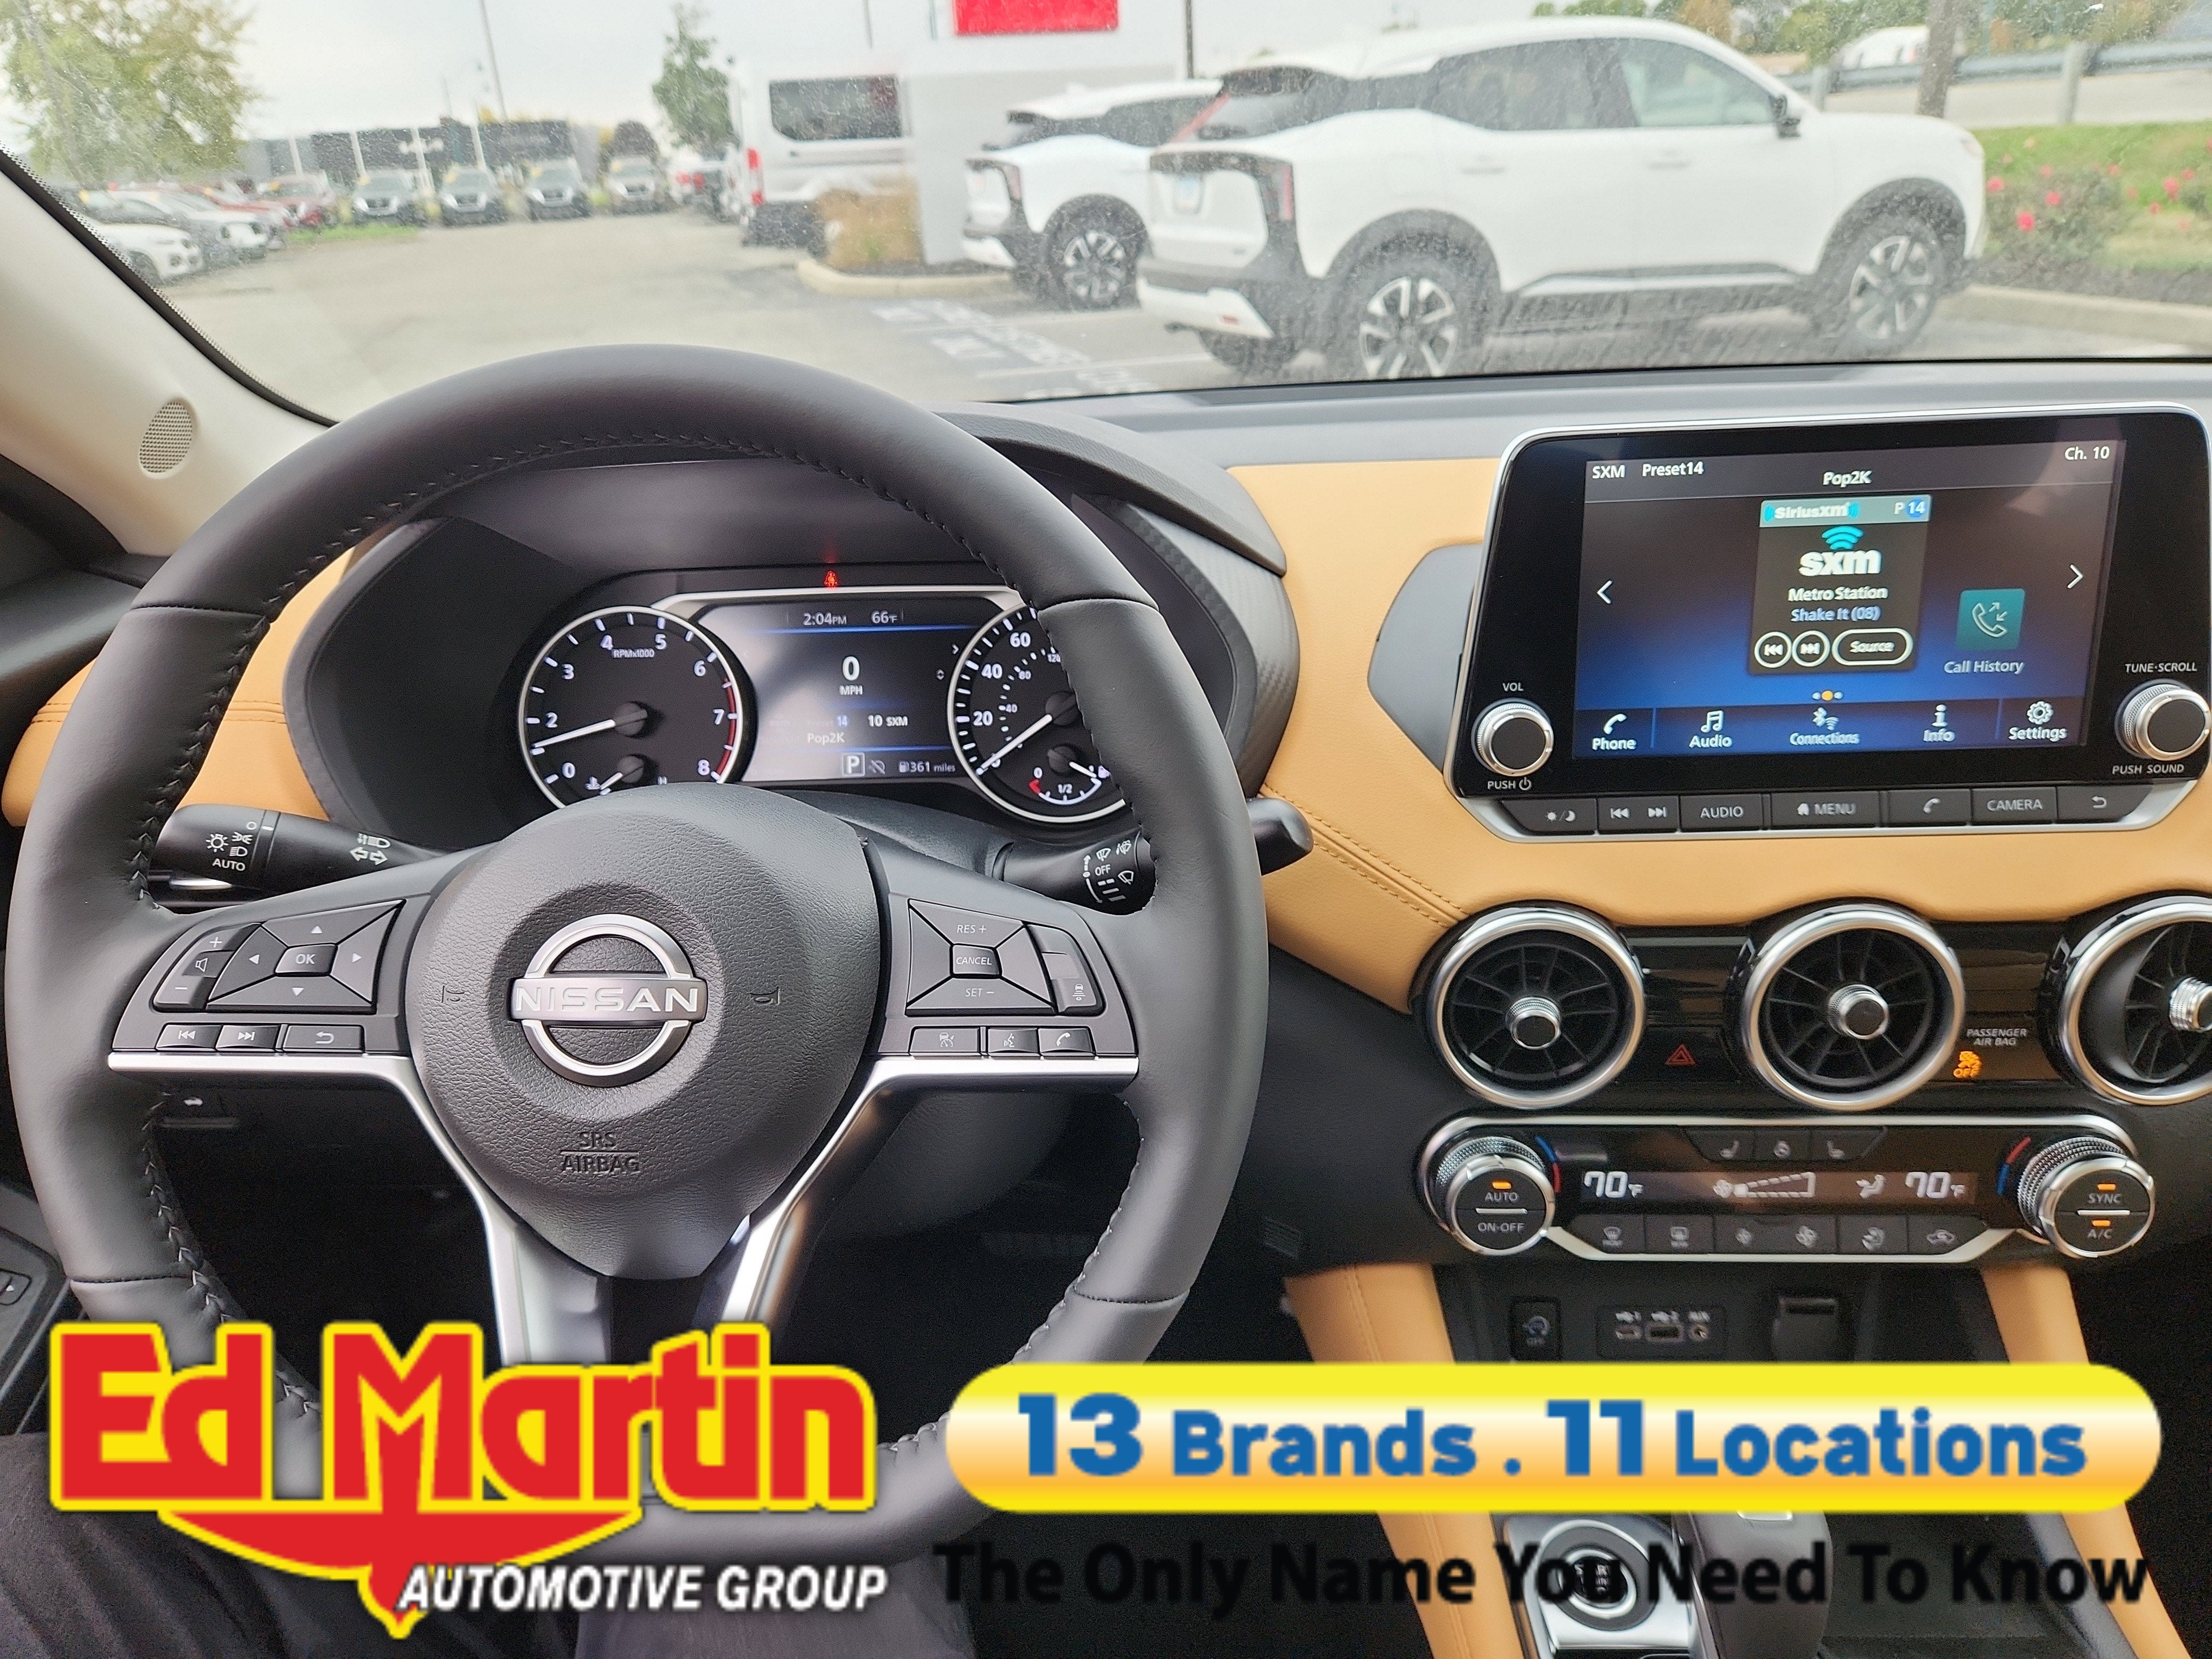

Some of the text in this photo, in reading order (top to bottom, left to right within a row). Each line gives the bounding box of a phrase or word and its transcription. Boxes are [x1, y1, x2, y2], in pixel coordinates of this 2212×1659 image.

[2063, 445, 2110, 460] Ch. 10
[1591, 461, 1705, 479] SXM Preset14
[1823, 470, 1872, 487] Pop2K
[1894, 500, 1926, 515] P 14
[1799, 549, 1881, 576] sxm
[1788, 585, 1889, 602] Metro Station
[1790, 605, 1881, 622] Shake It (08)
[600, 634, 613, 650] 4
[655, 633, 667, 650] 5
[1009, 632, 1031, 647] 60
[1849, 639, 1895, 653] Source
[563, 664, 575, 680] 3
[694, 660, 706, 677] 6
[841, 656, 860, 681] 0
[981, 664, 1003, 679] 40
[1944, 658, 2025, 674] Call History
[839, 685, 863, 695] MPH
[1502, 681, 1524, 692] VOL
[1005, 704, 1018, 713] 40
[545, 712, 558, 728] 2
[713, 709, 725, 725] 7
[838, 715, 848, 727] 14
[868, 715, 908, 727] 10 SXM
[973, 711, 993, 726] 20
[807, 732, 845, 745] Pop2K
[1689, 734, 1733, 749] Audio
[1789, 731, 1860, 747] Connections
[1923, 728, 1955, 743] Info
[2008, 725, 2067, 743] Settings
[1592, 736, 1636, 751] Phone
[562, 762, 575, 778] 0
[697, 760, 710, 775] 8
[846, 755, 860, 774] P
[910, 762, 956, 773] 361 miles
[2112, 763, 2185, 775] PUSH SOUND
[1033, 767, 1043, 779] 0
[1487, 779, 1516, 790] PUSH
[1700, 806, 1744, 819] AUDIO
[1814, 803, 1855, 815] MENU
[1986, 799, 2042, 811] CAMERA
[212, 858, 246, 872] AUTO
[1095, 864, 1111, 876] OFF
[956, 924, 976, 934] RES
[295, 953, 316, 966] OK
[956, 956, 992, 966] CANCEL
[964, 987, 983, 997] SET
[515, 987, 698, 1013] NISSAN
[1966, 1028, 2028, 1037] PASSENGER
[1973, 1038, 1991, 1046] AIR
[1953, 1068, 1979, 1078] OFF
[578, 1131, 616, 1149] SRS
[562, 1155, 640, 1174] AIRBAG
[1484, 1192, 1518, 1201] AUTO
[2087, 1194, 2121, 1204] SYNC
[2087, 1229, 2113, 1239] A/C
